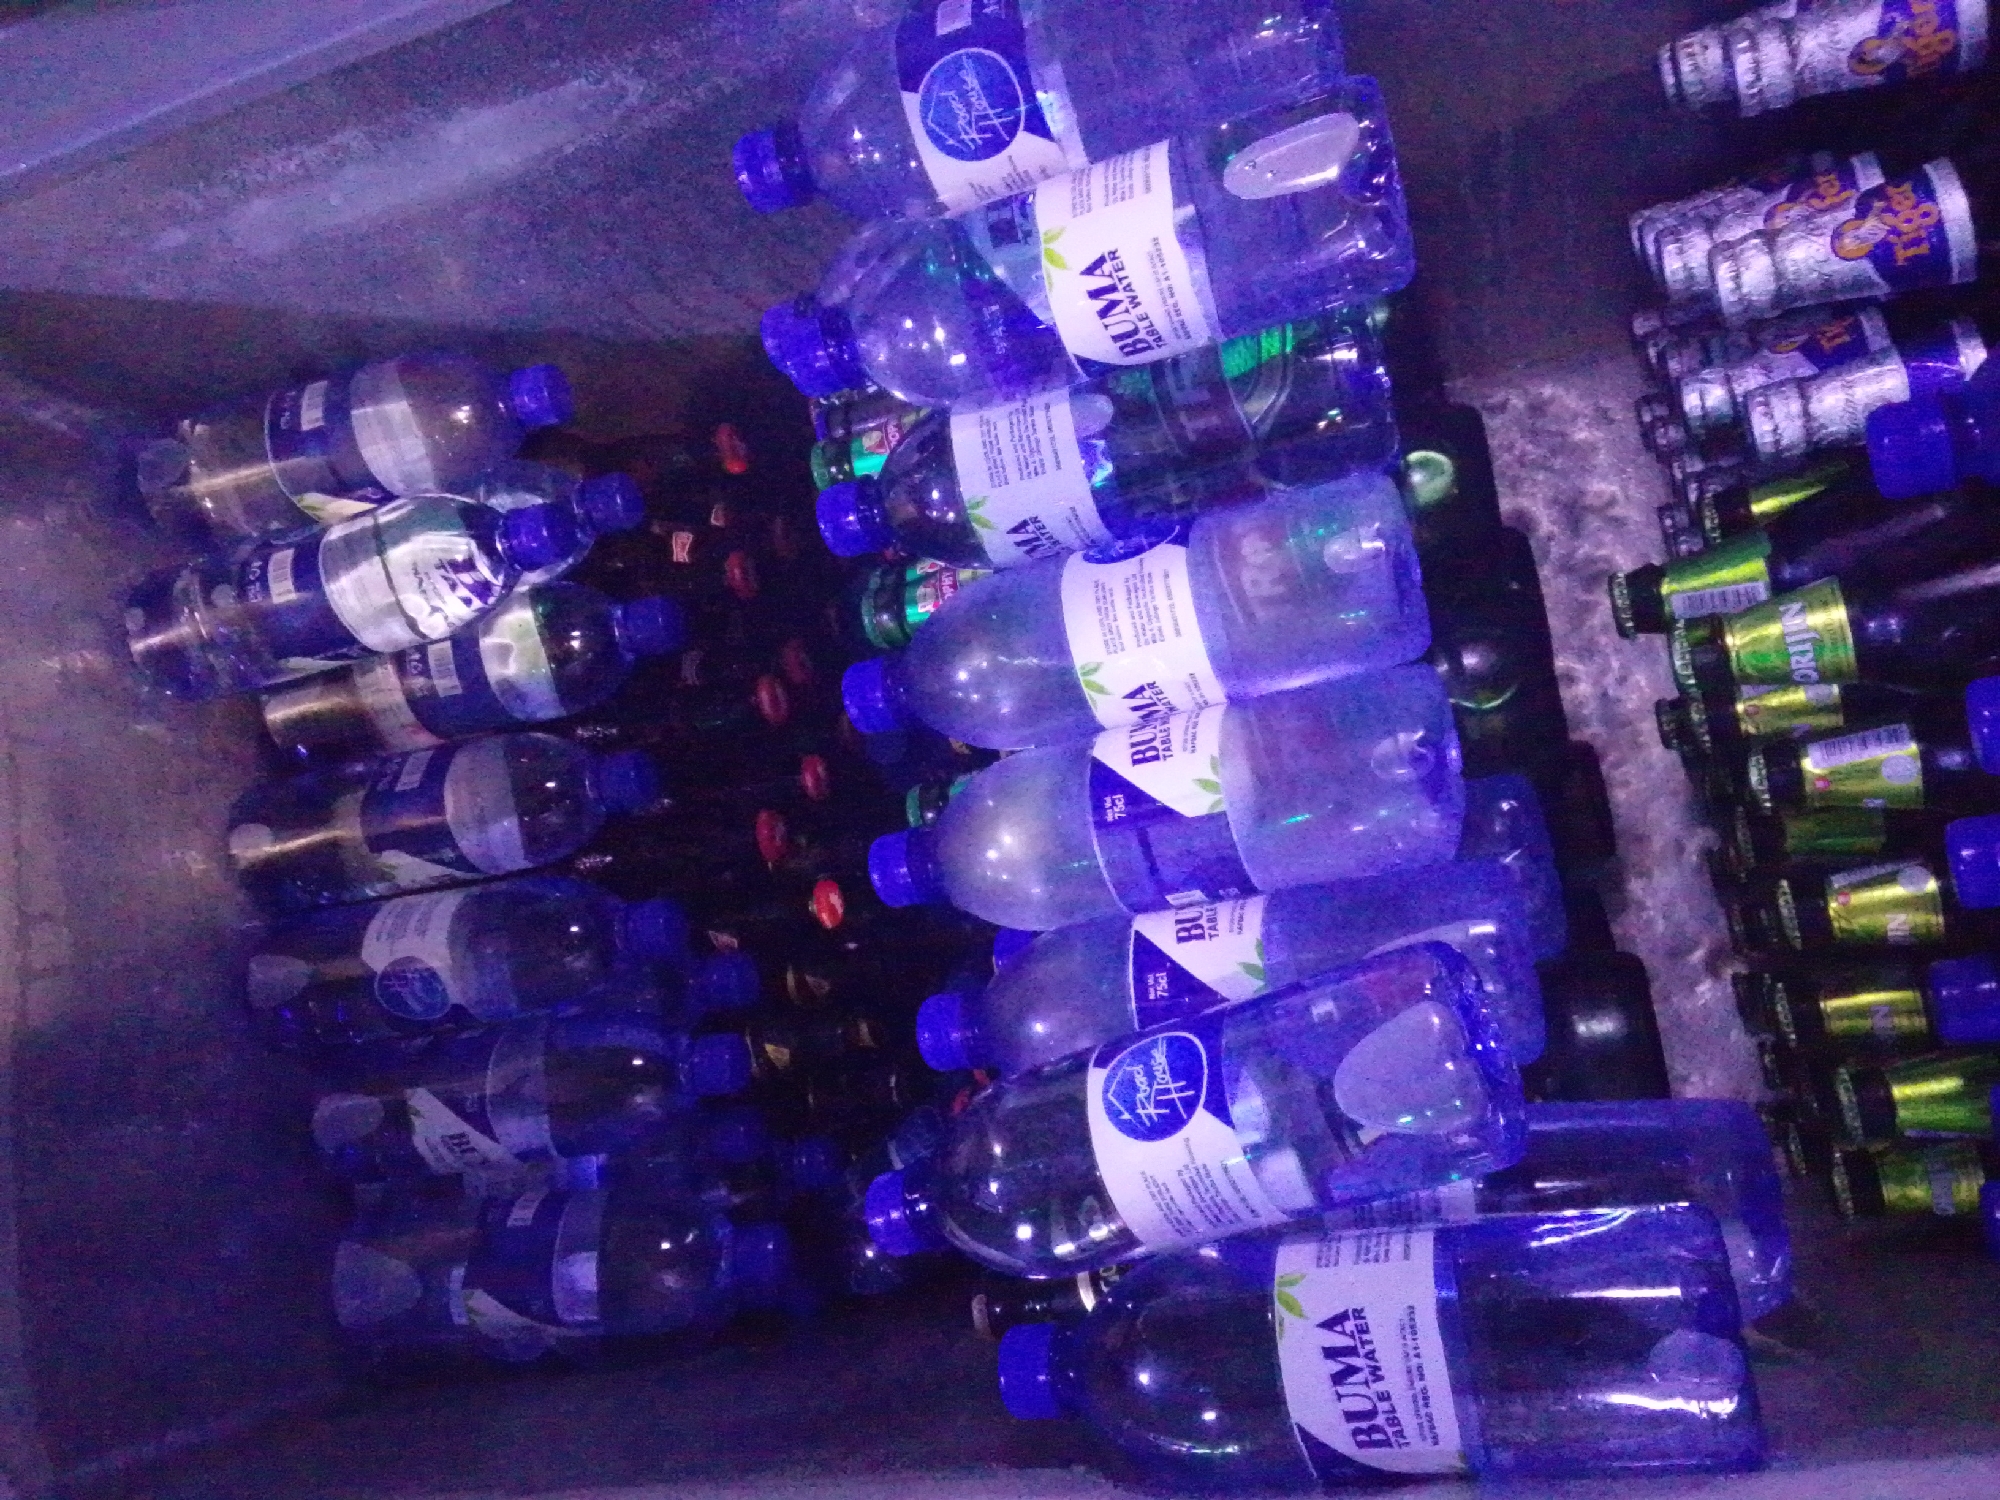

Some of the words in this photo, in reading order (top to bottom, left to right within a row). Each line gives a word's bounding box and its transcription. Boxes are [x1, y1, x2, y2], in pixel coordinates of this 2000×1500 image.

[1881, 181, 1940, 266] Tiger
[1079, 252, 1155, 358] BUMA
[1107, 247, 1142, 310] WATER
[1135, 311, 1168, 350] TABLE
[1779, 601, 1820, 684] ORIJIN
[1158, 726, 1174, 761] TABLE
[1112, 794, 1127, 820] 75cl
[1205, 906, 1220, 942] TABLE
[1155, 971, 1169, 999] 75cl
[1123, 1064, 1170, 1127] Road
[1150, 1036, 1197, 1121] House
[1351, 1306, 1386, 1384] WATER
[1315, 1308, 1394, 1450] BUMA
[1376, 1389, 1412, 1450] TABLE
